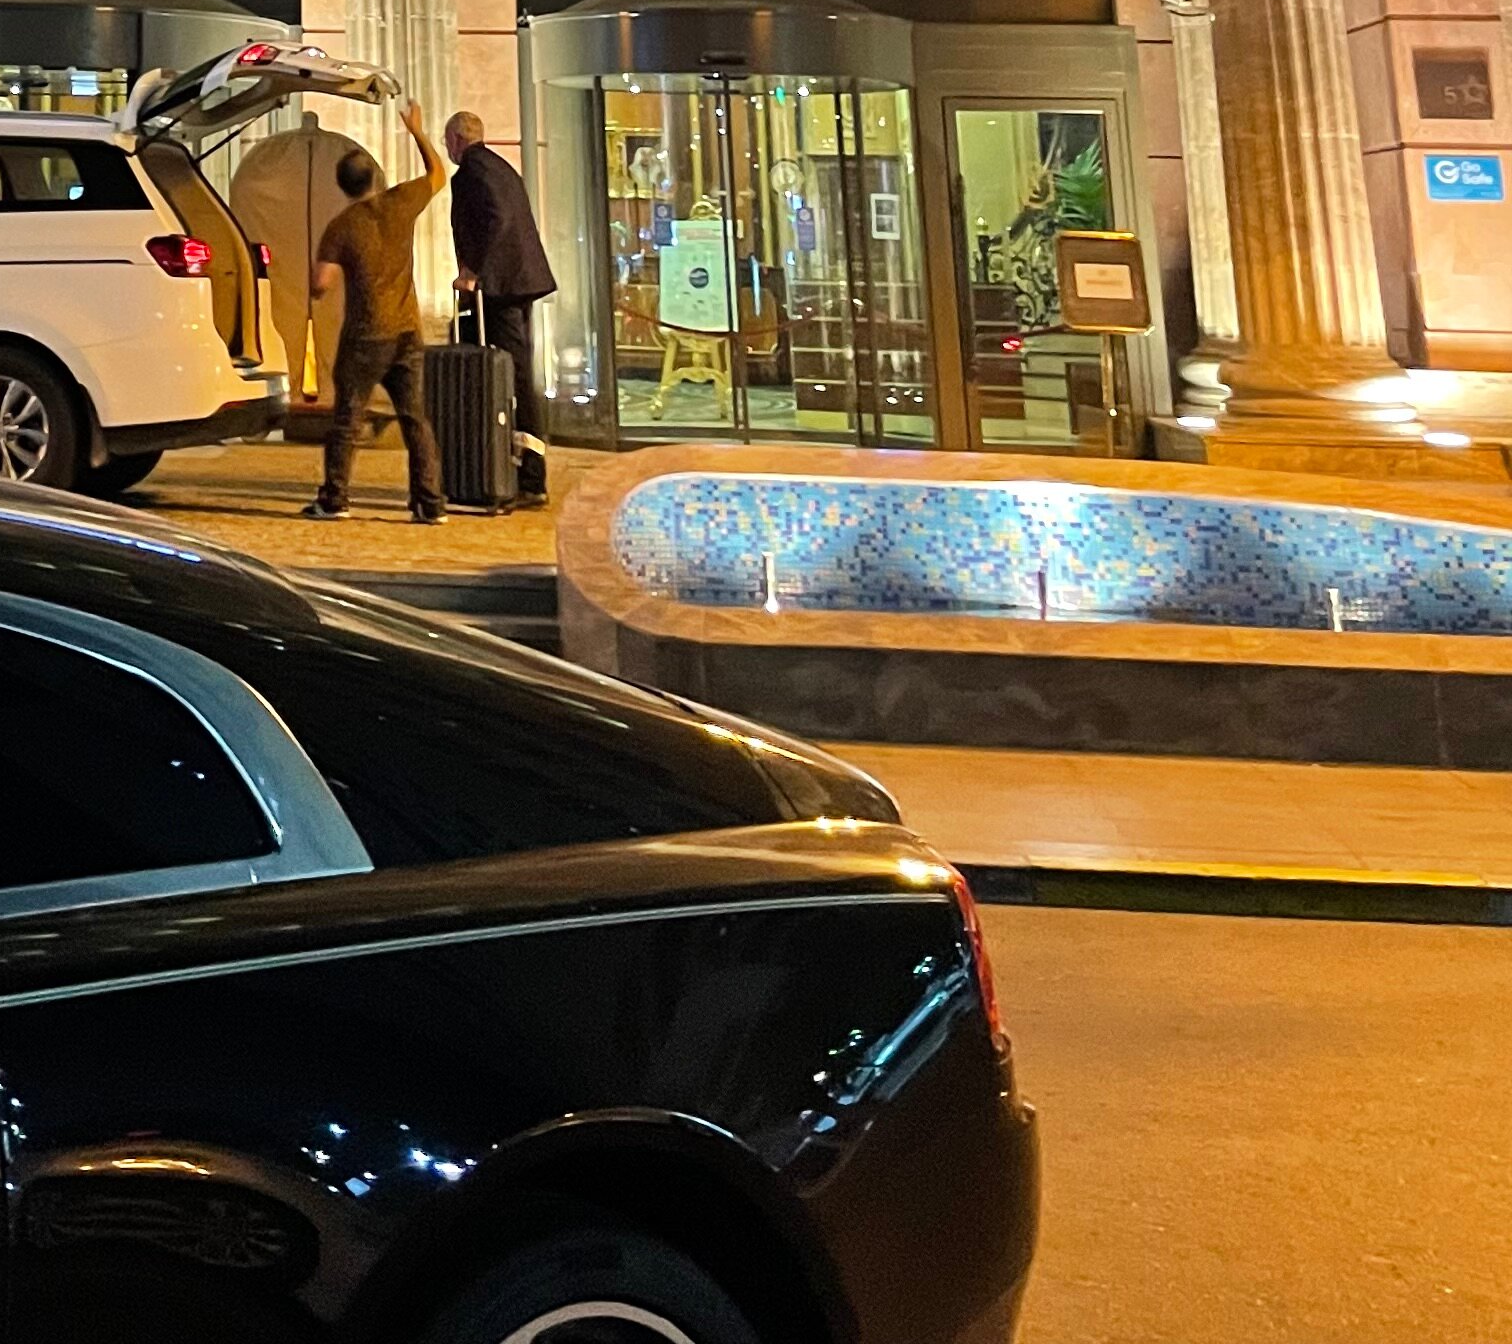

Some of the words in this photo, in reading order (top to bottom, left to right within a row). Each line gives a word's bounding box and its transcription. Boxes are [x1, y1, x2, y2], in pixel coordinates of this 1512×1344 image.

[1443, 85, 1457, 105] 5
[1460, 160, 1481, 173] Go
[1461, 172, 1494, 185] Safe
